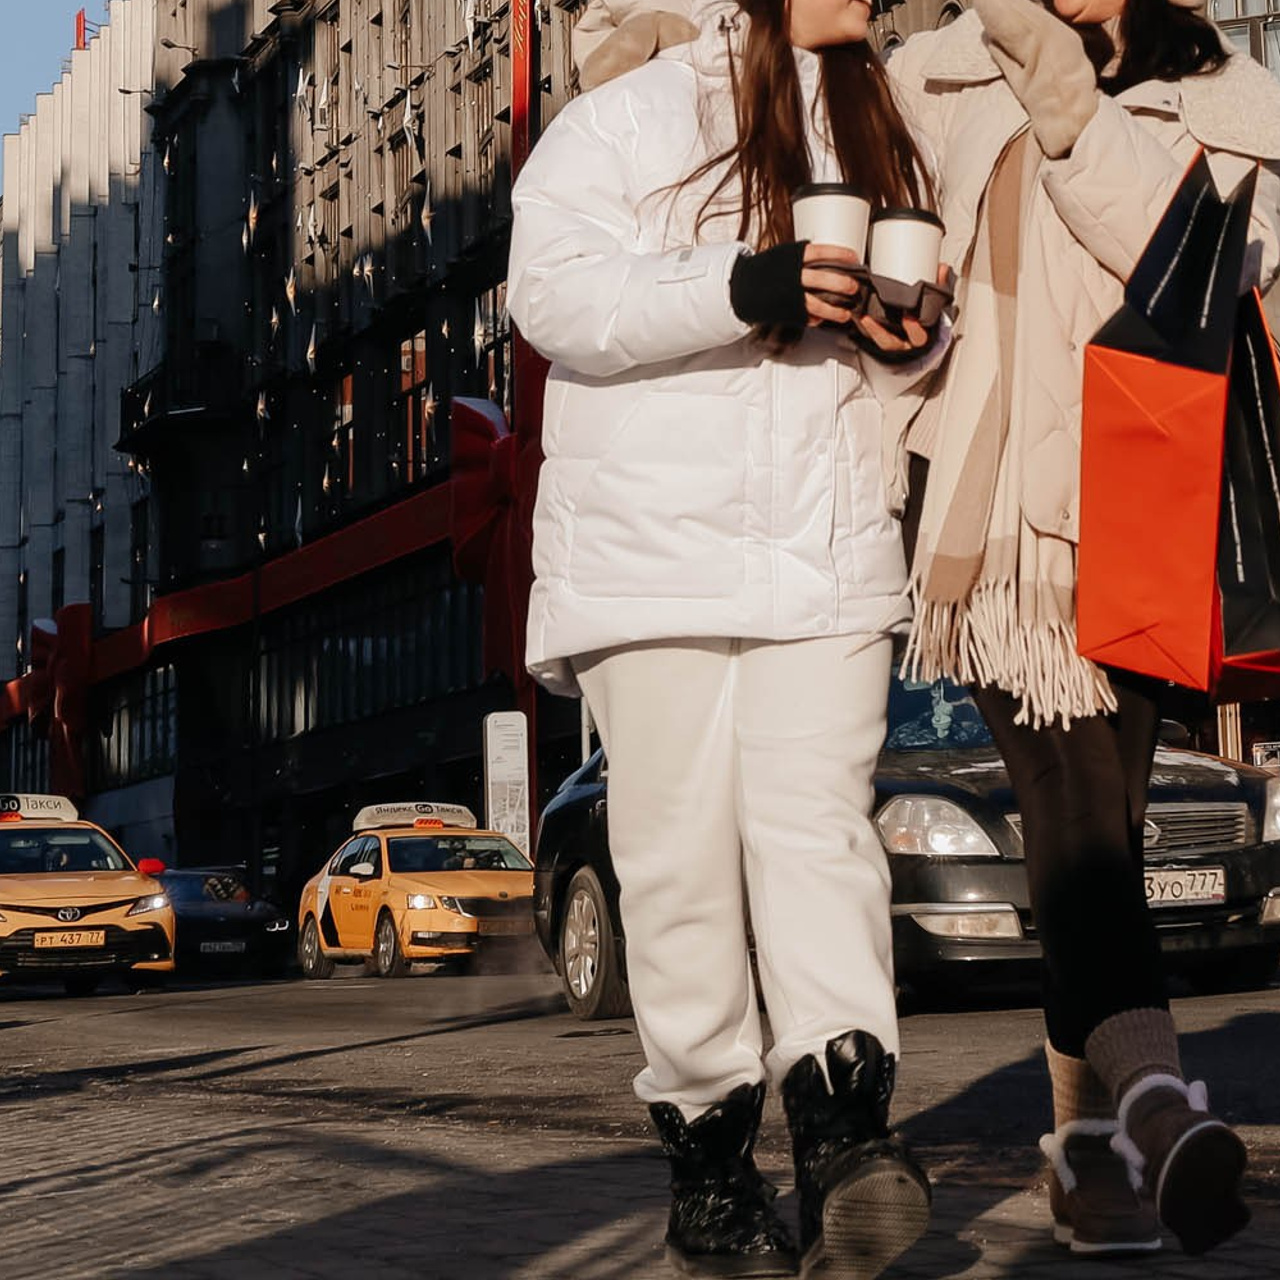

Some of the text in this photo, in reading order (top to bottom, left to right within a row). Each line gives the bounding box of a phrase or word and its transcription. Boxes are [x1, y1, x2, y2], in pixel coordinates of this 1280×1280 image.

[23, 797, 62, 810] Такси
[1187, 872, 1218, 891] 777
[60, 933, 82, 945] 437
